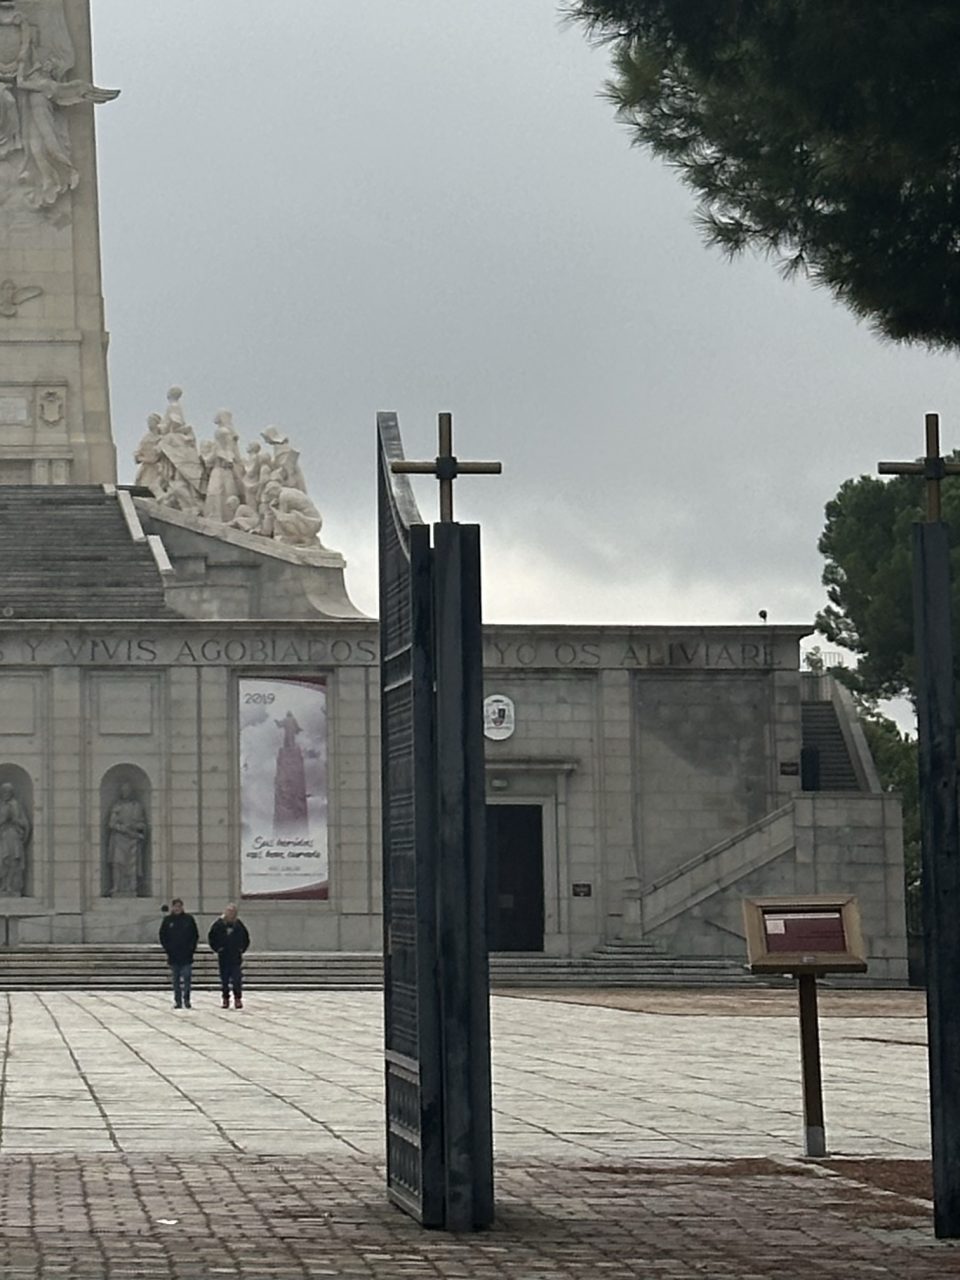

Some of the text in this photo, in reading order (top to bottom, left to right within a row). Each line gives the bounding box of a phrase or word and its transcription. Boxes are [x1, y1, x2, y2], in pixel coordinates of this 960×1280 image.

[24, 638, 43, 662] Y
[63, 639, 158, 662] VIVIS
[174, 638, 377, 662] AGOBIADOS
[493, 641, 538, 666] YO
[554, 641, 601, 666] OS
[618, 642, 783, 666] ALIVIARE
[244, 692, 276, 705] 2019
